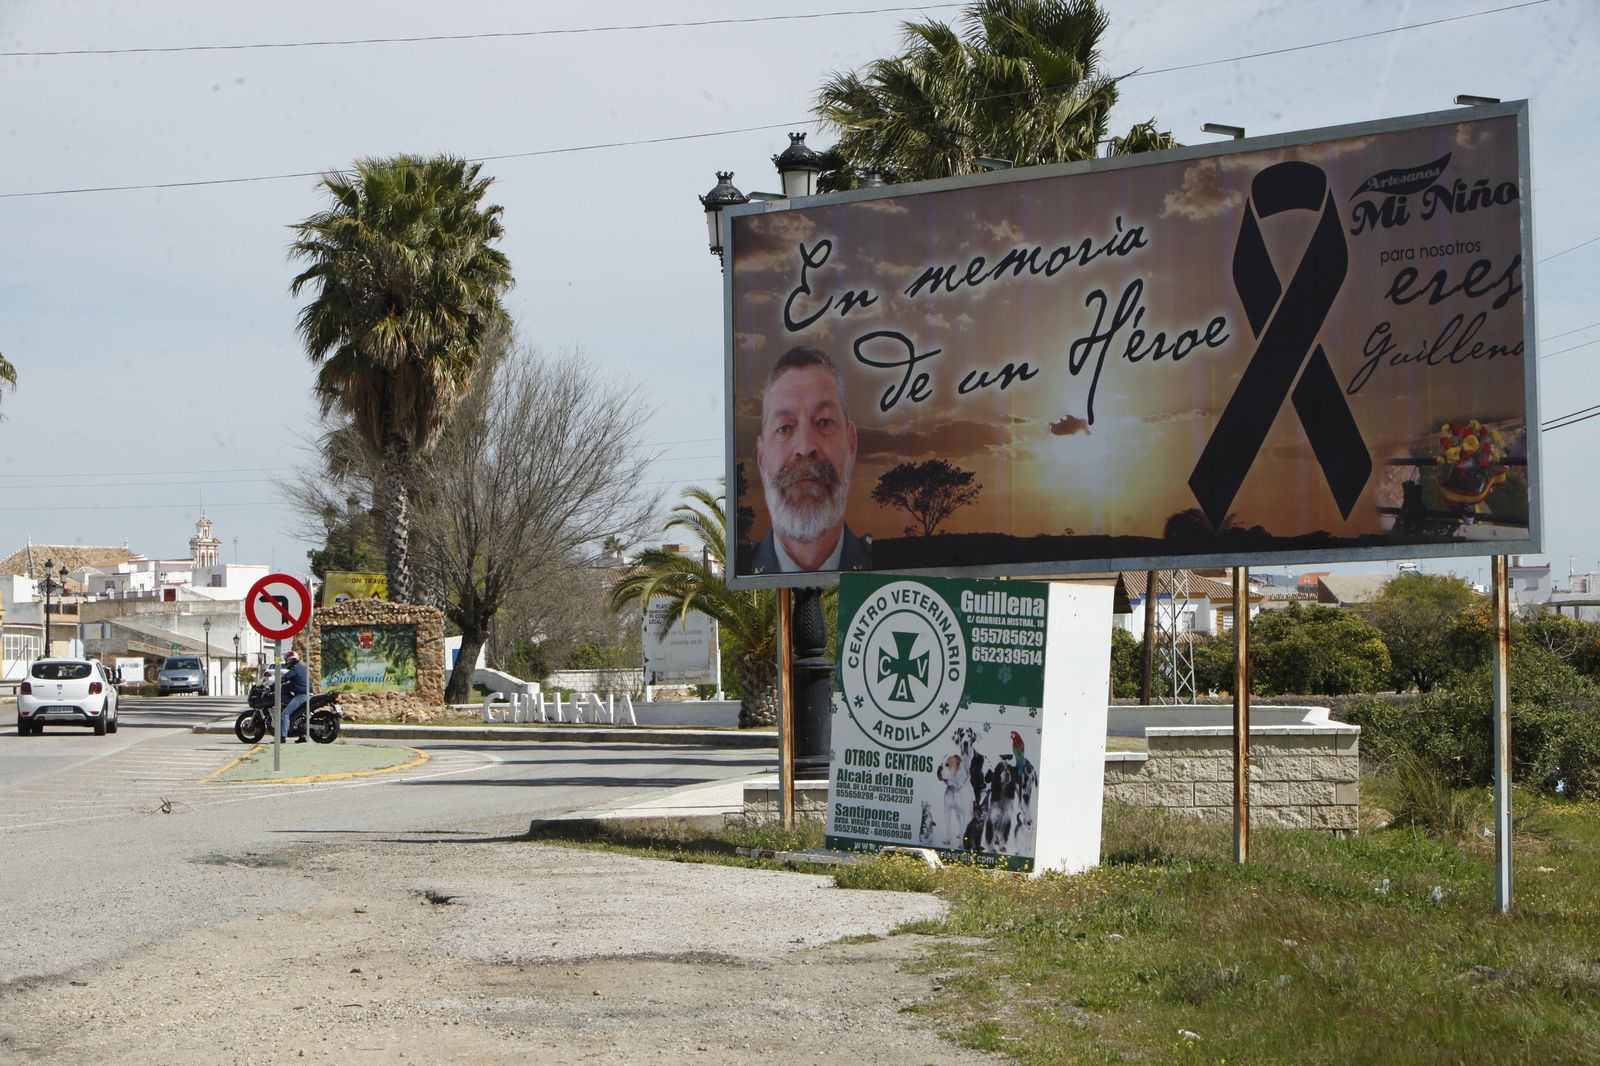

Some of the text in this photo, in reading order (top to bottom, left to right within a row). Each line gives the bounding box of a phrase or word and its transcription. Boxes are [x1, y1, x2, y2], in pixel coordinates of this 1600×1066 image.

[1350, 196, 1410, 236] Mi
[1380, 240, 1481, 266] para nosotros
[784, 216, 1148, 332] En memoria
[1384, 254, 1523, 310] eres
[959, 360, 1039, 395] un
[1069, 278, 1230, 426] Héroe
[960, 590, 1045, 617] Guillena
[967, 615, 974, 624] C/
[976, 616, 1006, 626] GABRIELA
[848, 589, 961, 682] CENTRO VETERINARIO
[971, 627, 1044, 647] 955785629
[879, 655, 928, 679] C V
[972, 646, 1043, 666] 652339514
[896, 678, 908, 700] A
[873, 719, 931, 741] ARDILA
[844, 748, 933, 773] OTROS CENTROS
[836, 768, 914, 788] Alcalá del Río
[835, 802, 900, 822] Santiponce
